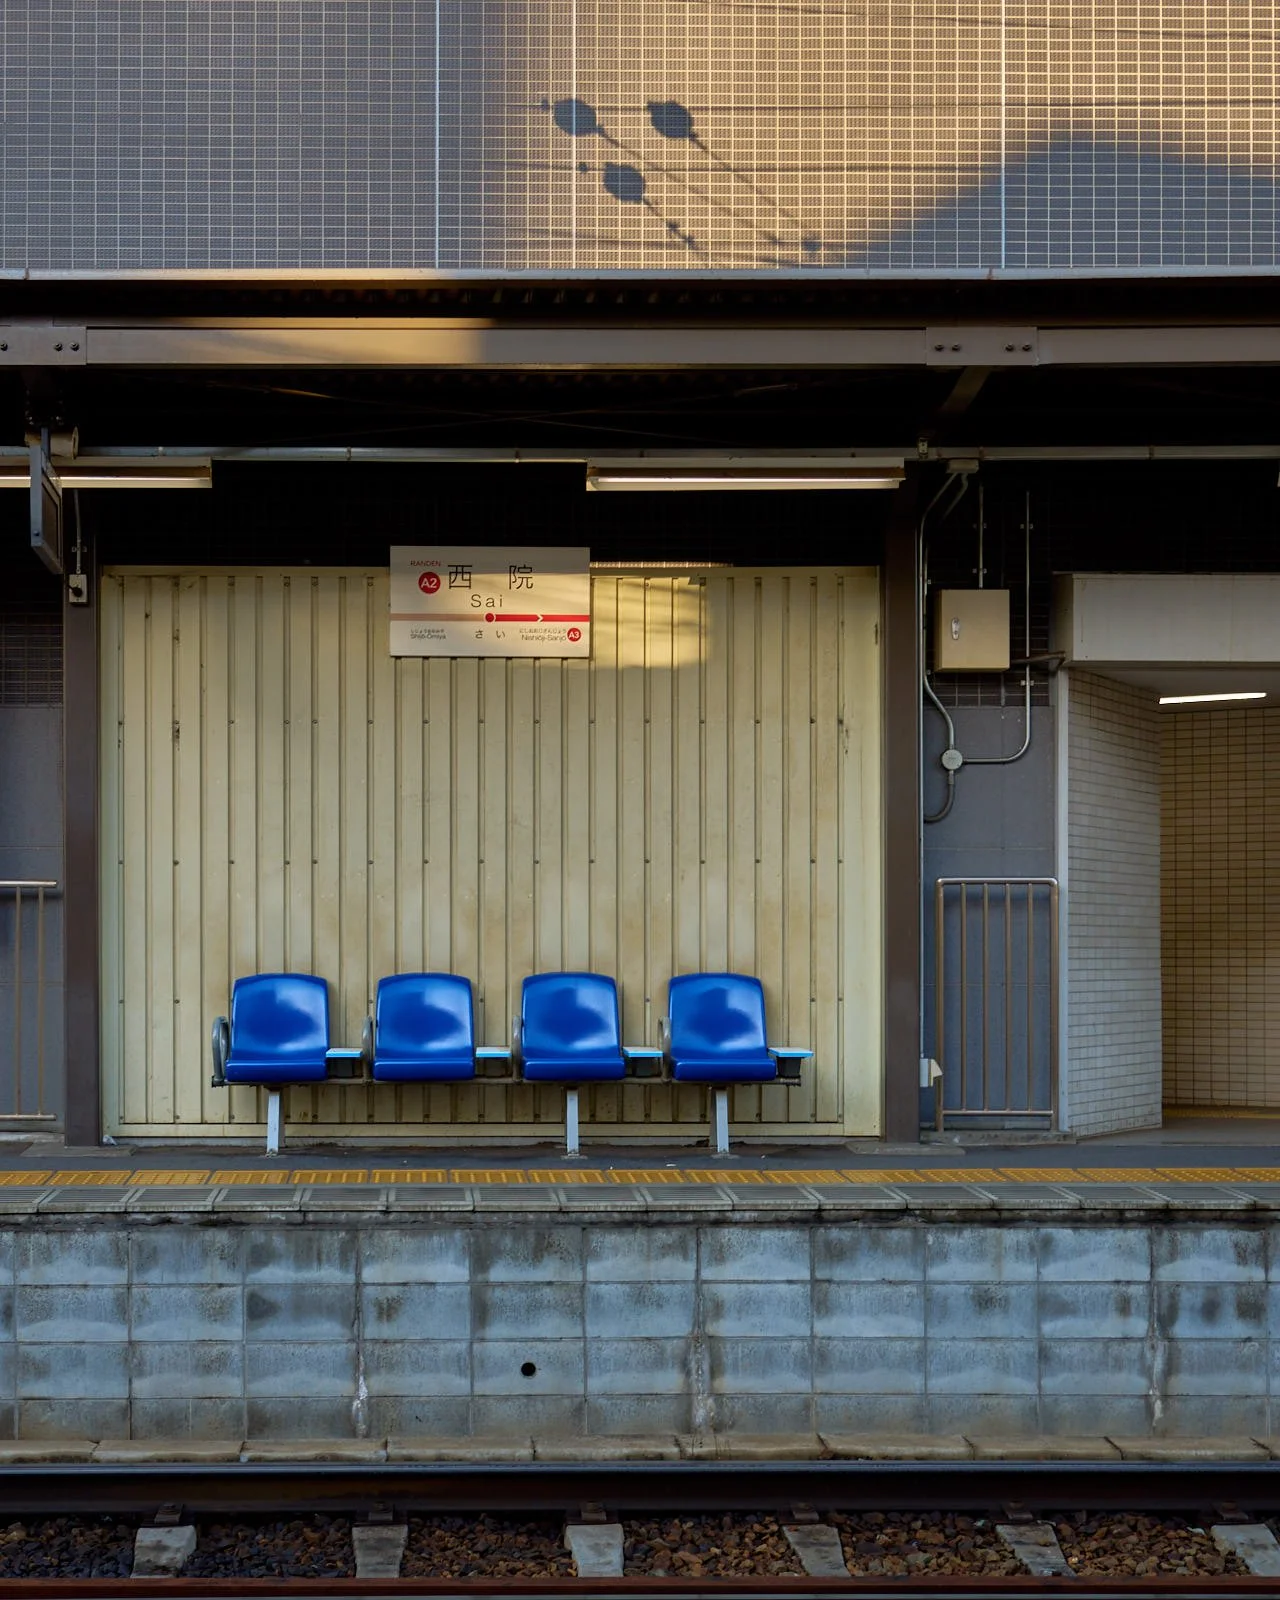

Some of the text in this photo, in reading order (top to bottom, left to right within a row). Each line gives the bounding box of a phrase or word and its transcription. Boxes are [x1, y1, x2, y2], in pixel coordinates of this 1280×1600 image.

[447, 563, 534, 590] 西院
[420, 577, 437, 589] A2
[470, 593, 504, 608] Sai
[474, 629, 506, 639] さい
[568, 630, 580, 639] A3
